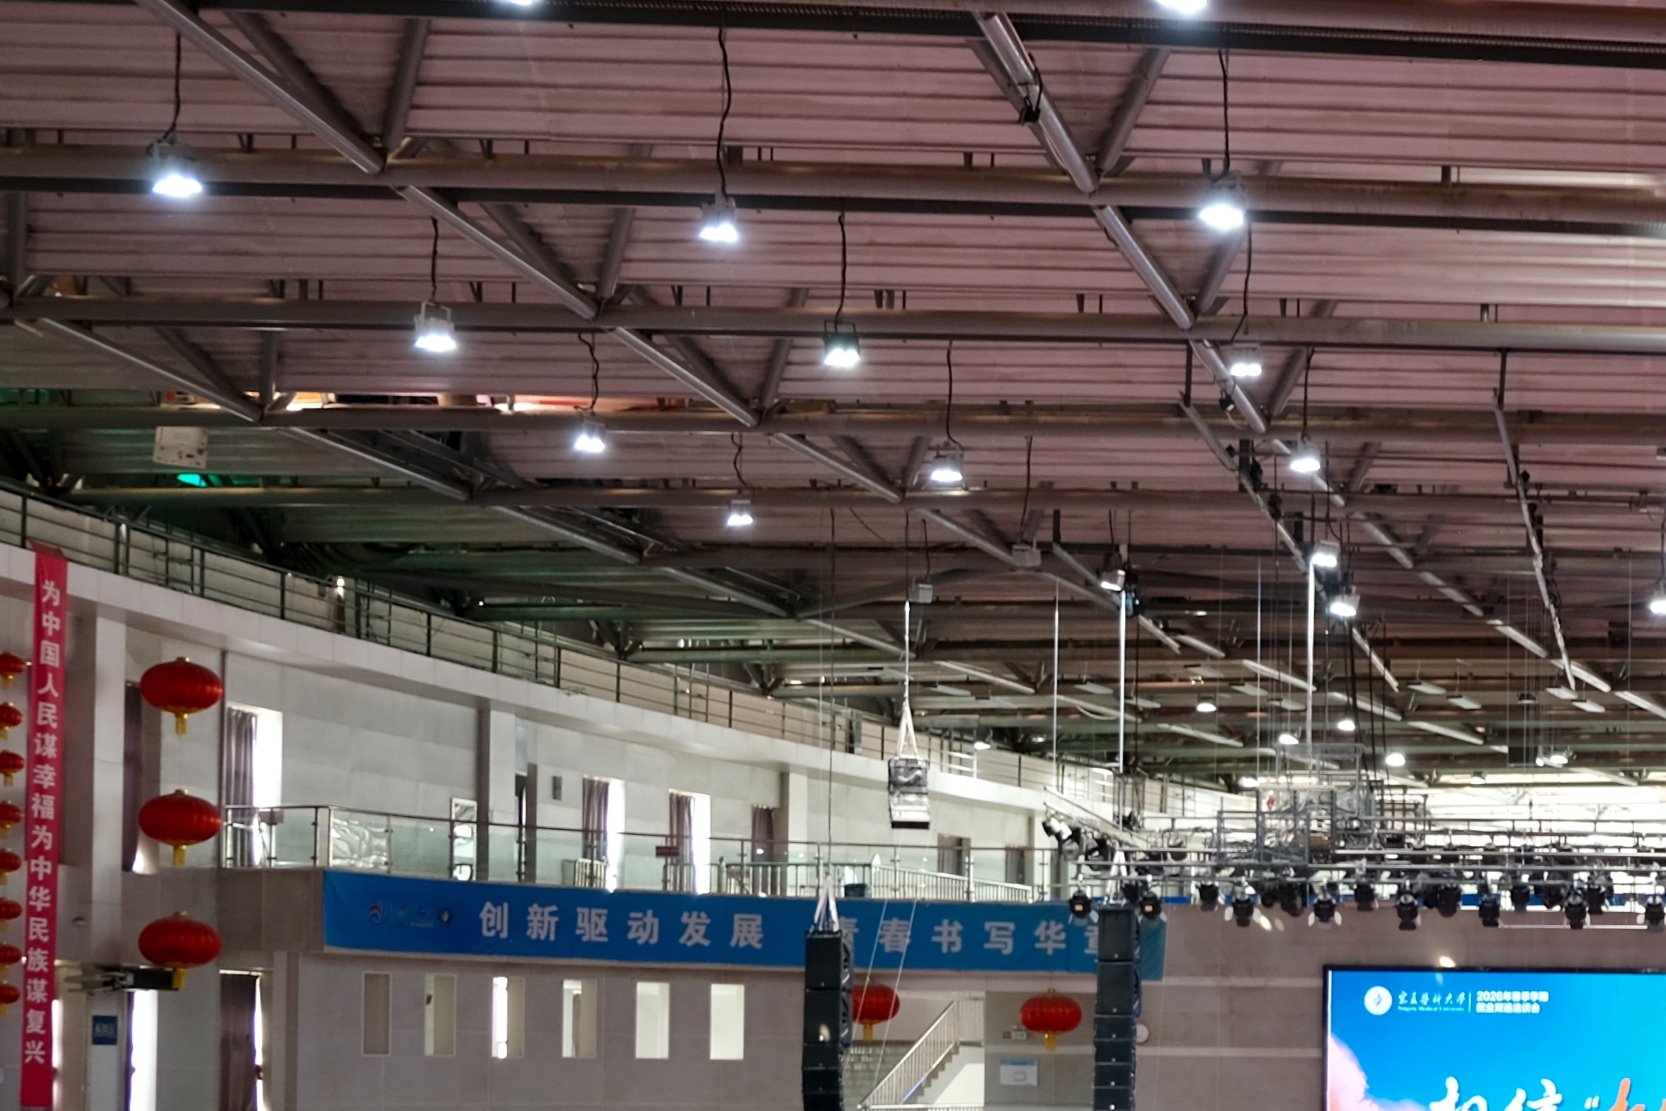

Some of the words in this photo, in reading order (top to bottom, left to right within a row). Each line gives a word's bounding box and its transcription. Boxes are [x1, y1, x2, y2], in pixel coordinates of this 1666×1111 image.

[24, 578, 62, 1066] 为中国人民谋幸福为中华民族谋复兴
[479, 901, 764, 949] 创新驱动发展
